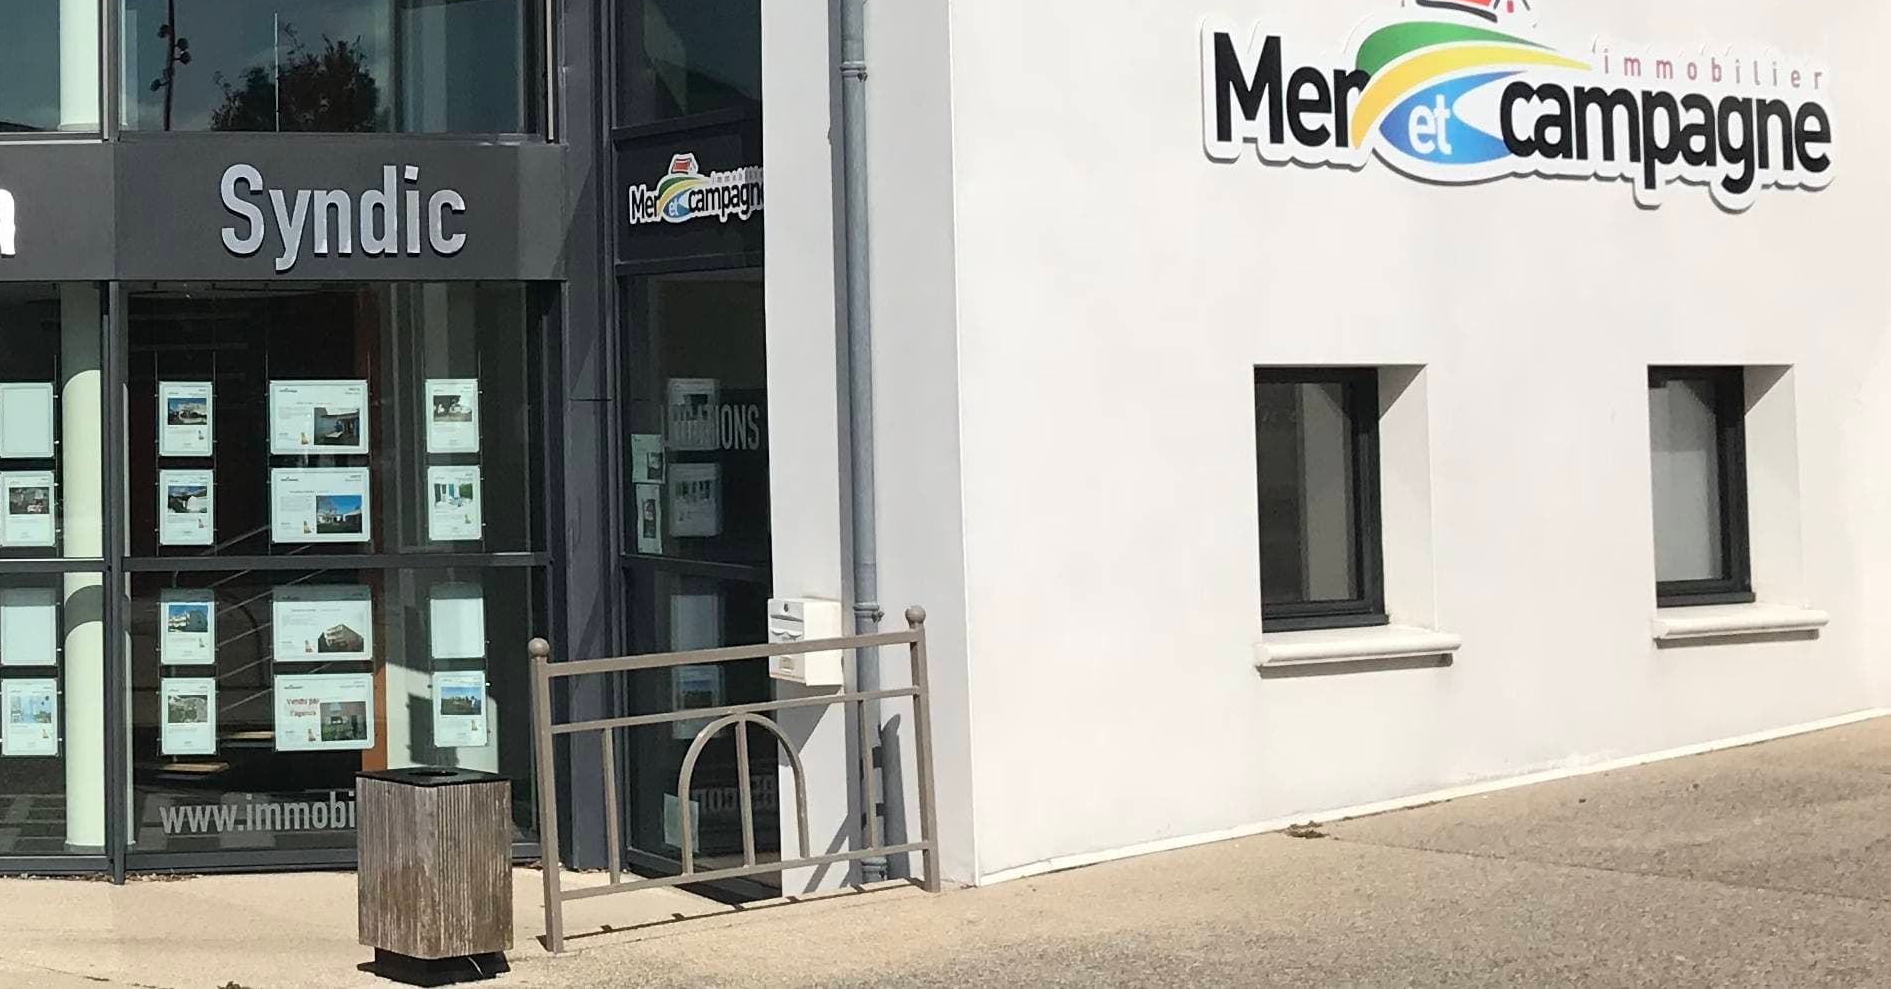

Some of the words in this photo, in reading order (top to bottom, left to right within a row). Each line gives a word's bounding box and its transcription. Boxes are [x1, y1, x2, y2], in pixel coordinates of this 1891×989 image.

[1604, 49, 1822, 90] immobilier
[1214, 31, 1368, 148] Mer
[1410, 94, 1452, 155] et
[1500, 81, 1832, 195] campagne
[220, 164, 467, 271] Syndic
[631, 188, 661, 219] Mer
[688, 181, 763, 217] campagn
[159, 790, 355, 834] www.immobi
